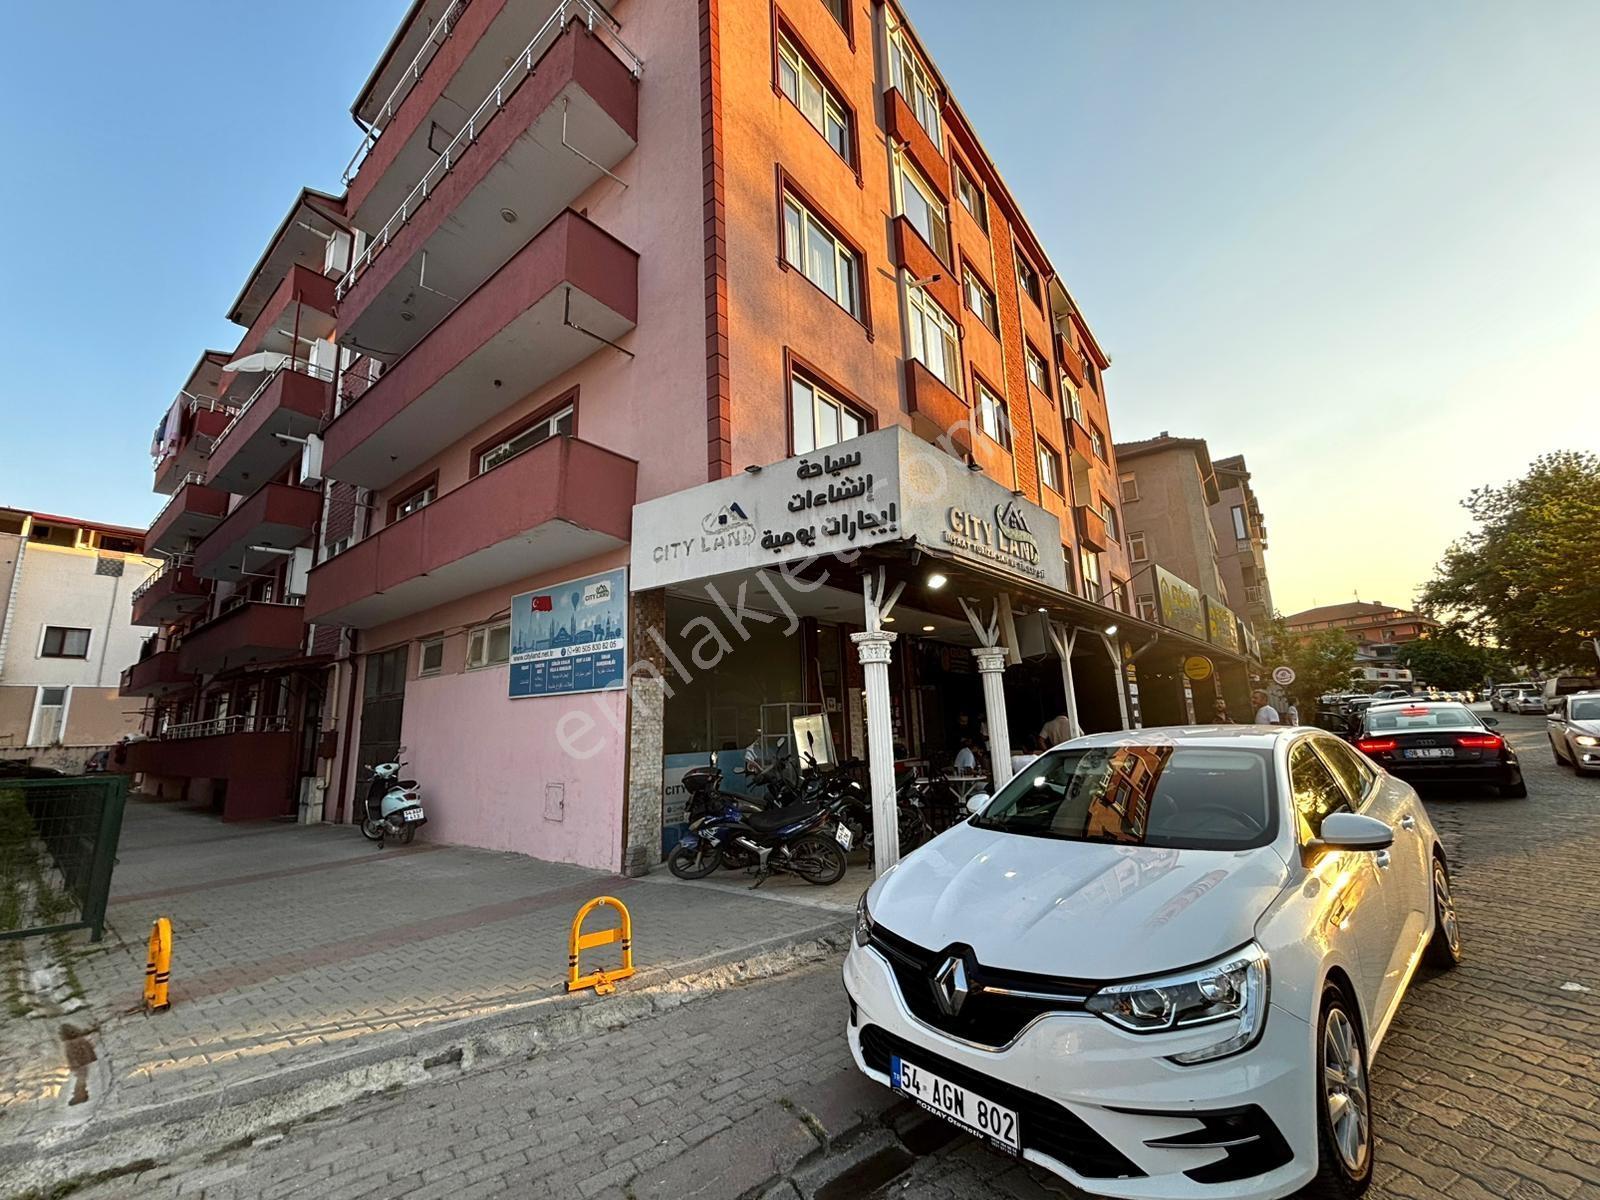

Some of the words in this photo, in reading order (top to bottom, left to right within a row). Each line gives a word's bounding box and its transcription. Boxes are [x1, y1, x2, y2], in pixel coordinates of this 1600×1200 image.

[796, 451, 862, 480] سياحة
[787, 473, 875, 513] إنشاءات
[820, 502, 898, 541] إيجارات
[947, 505, 993, 546] CITY
[996, 526, 1040, 566] LAND
[652, 538, 695, 564] CITY
[760, 525, 817, 554] يومية
[665, 785, 686, 795] CITY
[901, 1062, 921, 1095] 54
[932, 1078, 965, 1119] AGN
[977, 1100, 1016, 1144] 802
